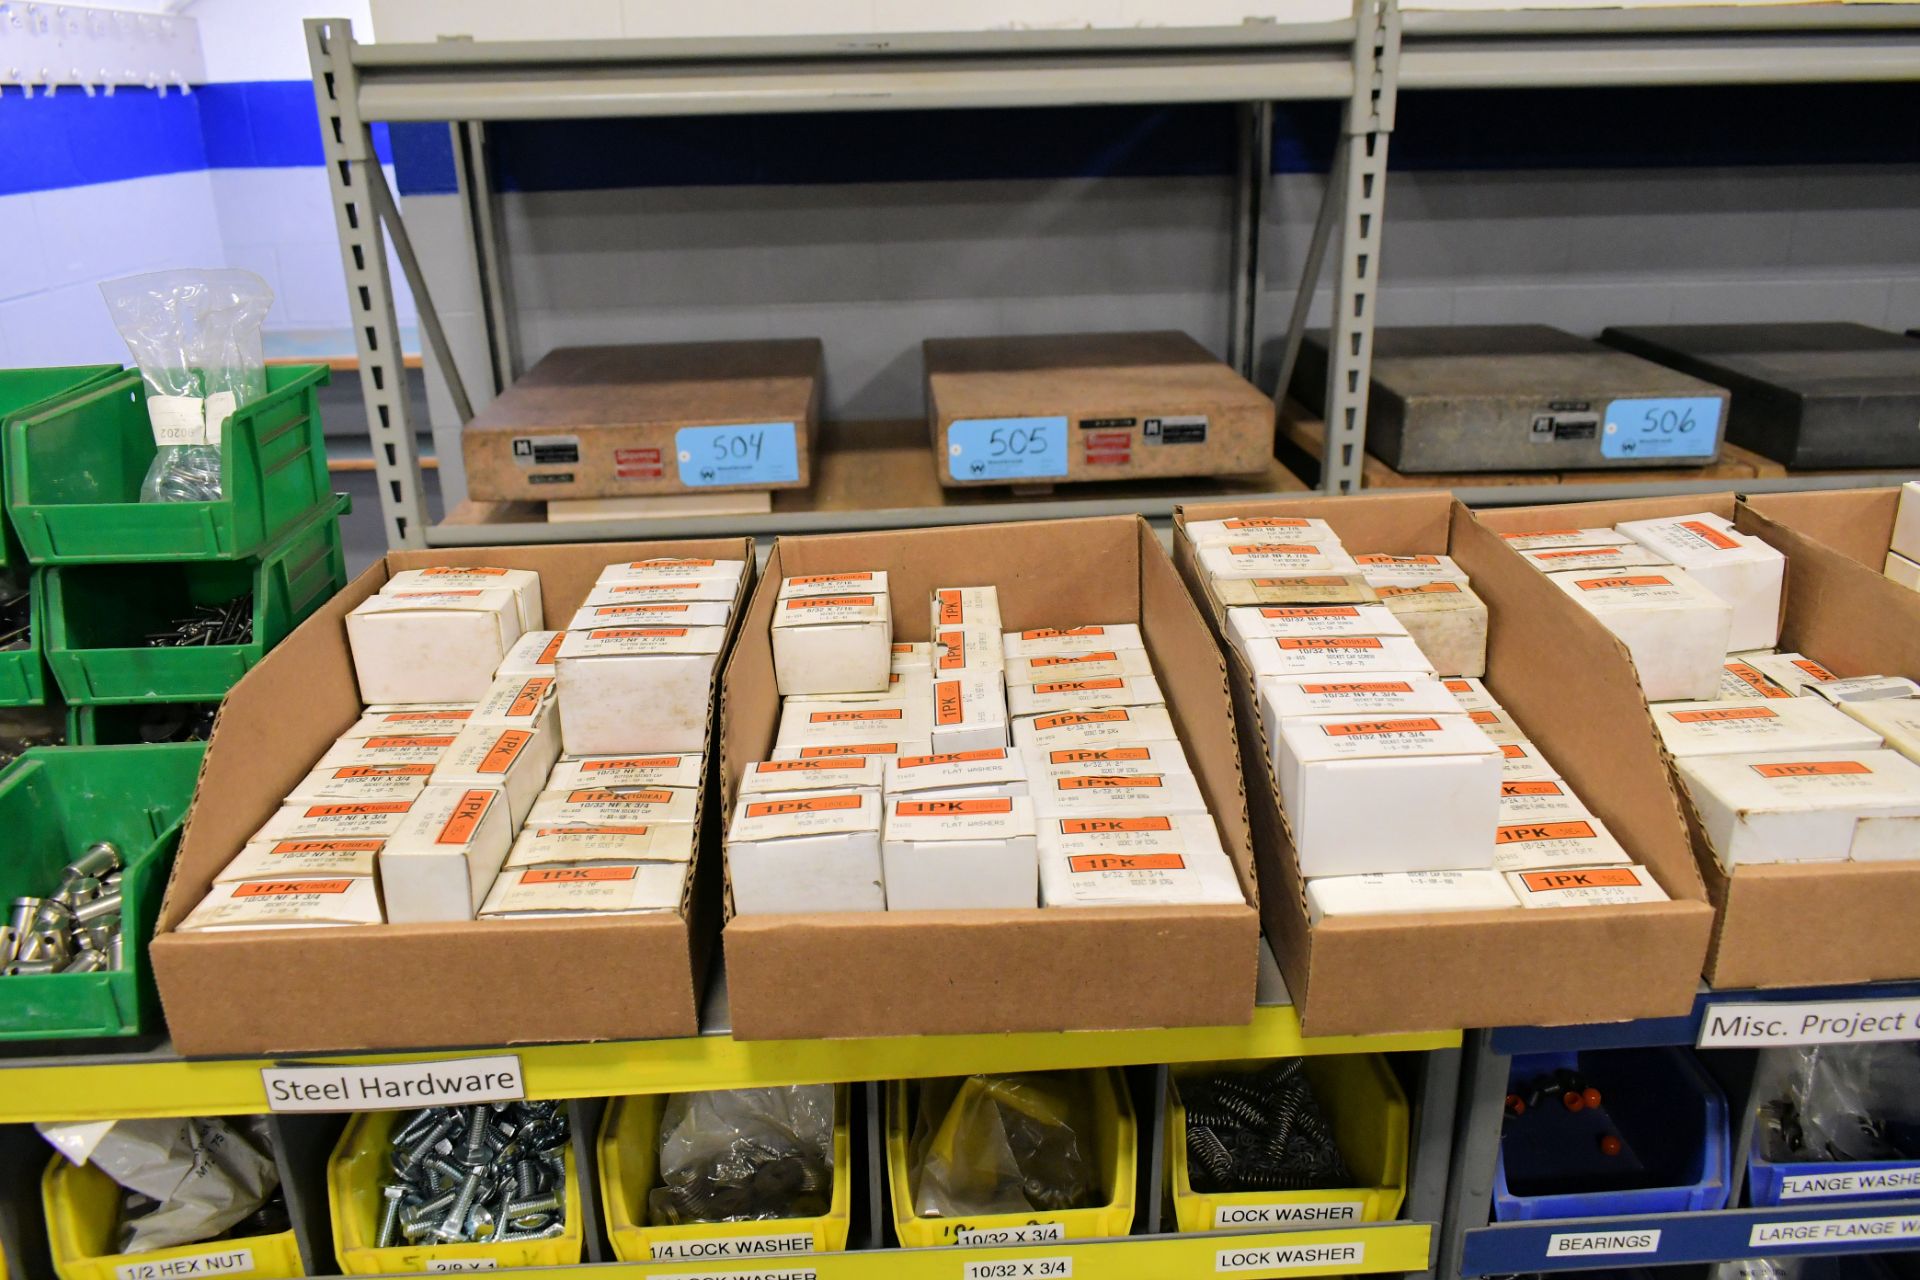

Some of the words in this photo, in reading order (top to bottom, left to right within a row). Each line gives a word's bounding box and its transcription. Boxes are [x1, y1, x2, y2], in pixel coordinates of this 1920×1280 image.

[1641, 408, 1696, 433] 506
[713, 430, 763, 460] 504
[990, 427, 1047, 456] 505
[1593, 579, 1634, 588] 1PK
[947, 602, 959, 618] 1PK
[948, 647, 960, 663] 1PK
[522, 682, 543, 701] 1PK
[942, 696, 956, 717] 1PK
[1049, 715, 1091, 726] 1PK
[1343, 724, 1390, 733] 1PK
[495, 736, 521, 754] 1PK
[919, 753, 961, 763] 1PK
[1065, 751, 1108, 760] 1PK
[596, 761, 638, 769] 1PK
[775, 760, 820, 769] 1PK
[1774, 766, 1821, 775] 1PK
[324, 806, 367, 814] 1PK
[457, 795, 486, 820] 1PK
[763, 802, 813, 812] 1PK
[913, 802, 963, 811] 1PK
[1079, 822, 1124, 831] 1PK
[1499, 828, 1551, 839] 1PK
[1088, 859, 1136, 869] 1PK
[543, 870, 589, 879] 1PK
[1539, 875, 1593, 887] 1PK
[254, 884, 301, 892] 1PK
[1711, 1016, 1787, 1036] Misc.
[1800, 1012, 1905, 1038] Project
[272, 1077, 349, 1101] Steel
[360, 1072, 515, 1099] Hardware
[1781, 1177, 1855, 1194] FLANGE
[1222, 1209, 1270, 1223] LOCK
[1276, 1207, 1354, 1220] WASHER
[963, 1233, 1009, 1244] 10/32
[1015, 1232, 1025, 1241] X
[1032, 1229, 1058, 1241] 3/4
[1759, 1226, 1819, 1241] LARGE
[1824, 1221, 1894, 1237] FLANGE
[649, 1246, 673, 1259] 1/4
[680, 1243, 730, 1257] LOCK
[1558, 1234, 1652, 1252] BEARINGS
[1222, 1252, 1270, 1267] LOCK
[1276, 1247, 1355, 1262] WASHER
[128, 1266, 154, 1280] 1/2
[160, 1262, 201, 1275] HEX
[206, 1254, 245, 1269] NUT
[972, 1265, 1016, 1278] 10/32
[1023, 1264, 1034, 1275] X
[1040, 1261, 1065, 1274] 3/4
